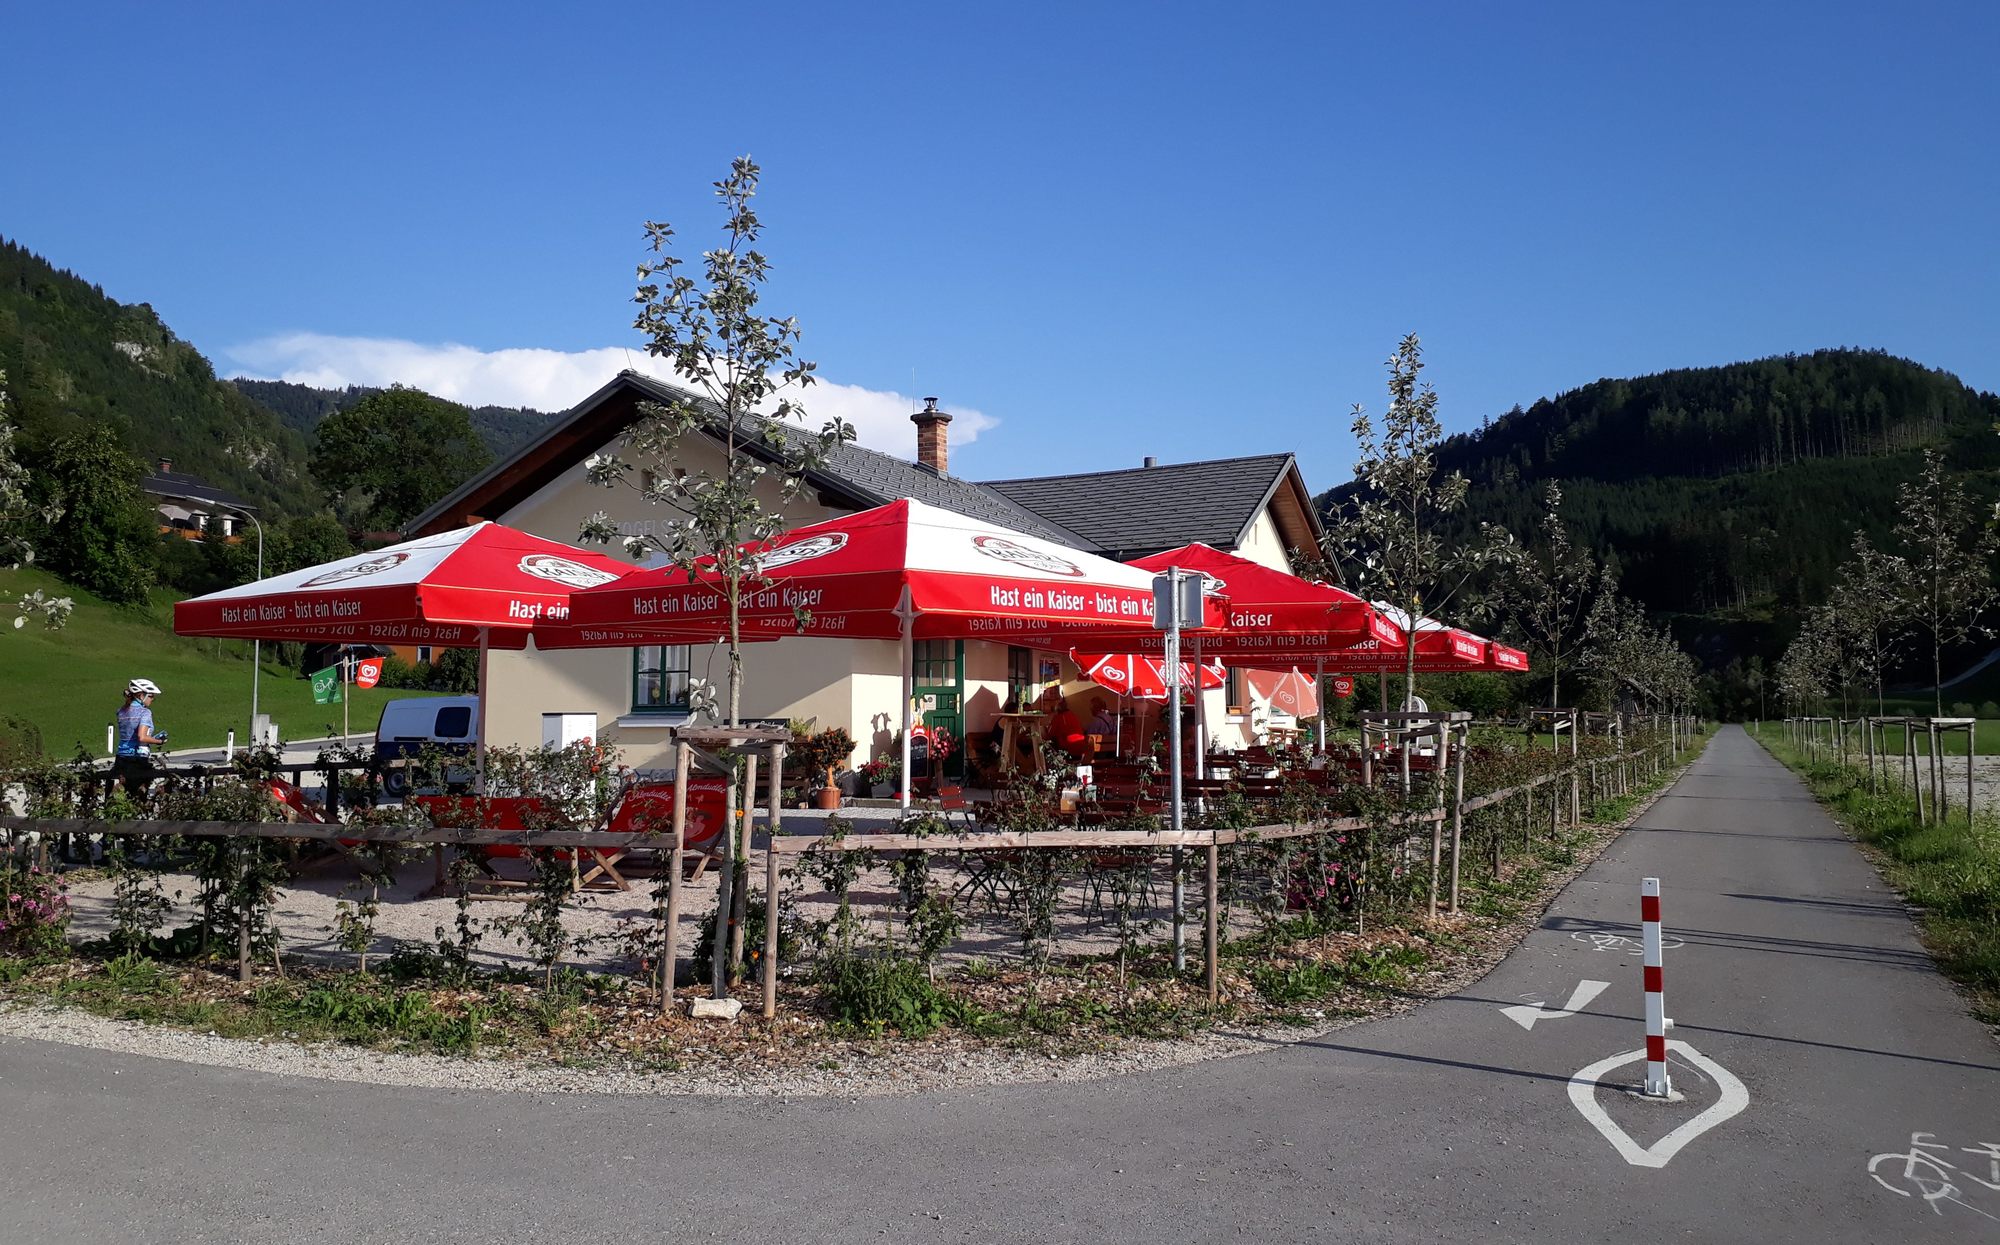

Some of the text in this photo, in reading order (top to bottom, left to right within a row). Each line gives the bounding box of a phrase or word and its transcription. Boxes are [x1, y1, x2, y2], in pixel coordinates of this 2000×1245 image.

[222, 606, 241, 622] Hast
[243, 605, 257, 621] ein
[259, 604, 286, 620] Kaiser
[295, 600, 312, 618] bist
[315, 600, 329, 617] ein
[332, 598, 362, 616] Kaiser
[509, 600, 570, 620] Hast ein
[634, 596, 658, 615] Hast
[661, 594, 679, 613] ein
[683, 593, 719, 612] Kaiser
[737, 588, 753, 609] ist
[758, 587, 778, 607] ein
[783, 586, 823, 606] Kaiser
[991, 586, 1020, 607] Hast
[1024, 588, 1044, 609] ein
[1048, 590, 1085, 611] Kaiser
[1096, 592, 1118, 614] bist
[1122, 596, 1139, 616] ein
